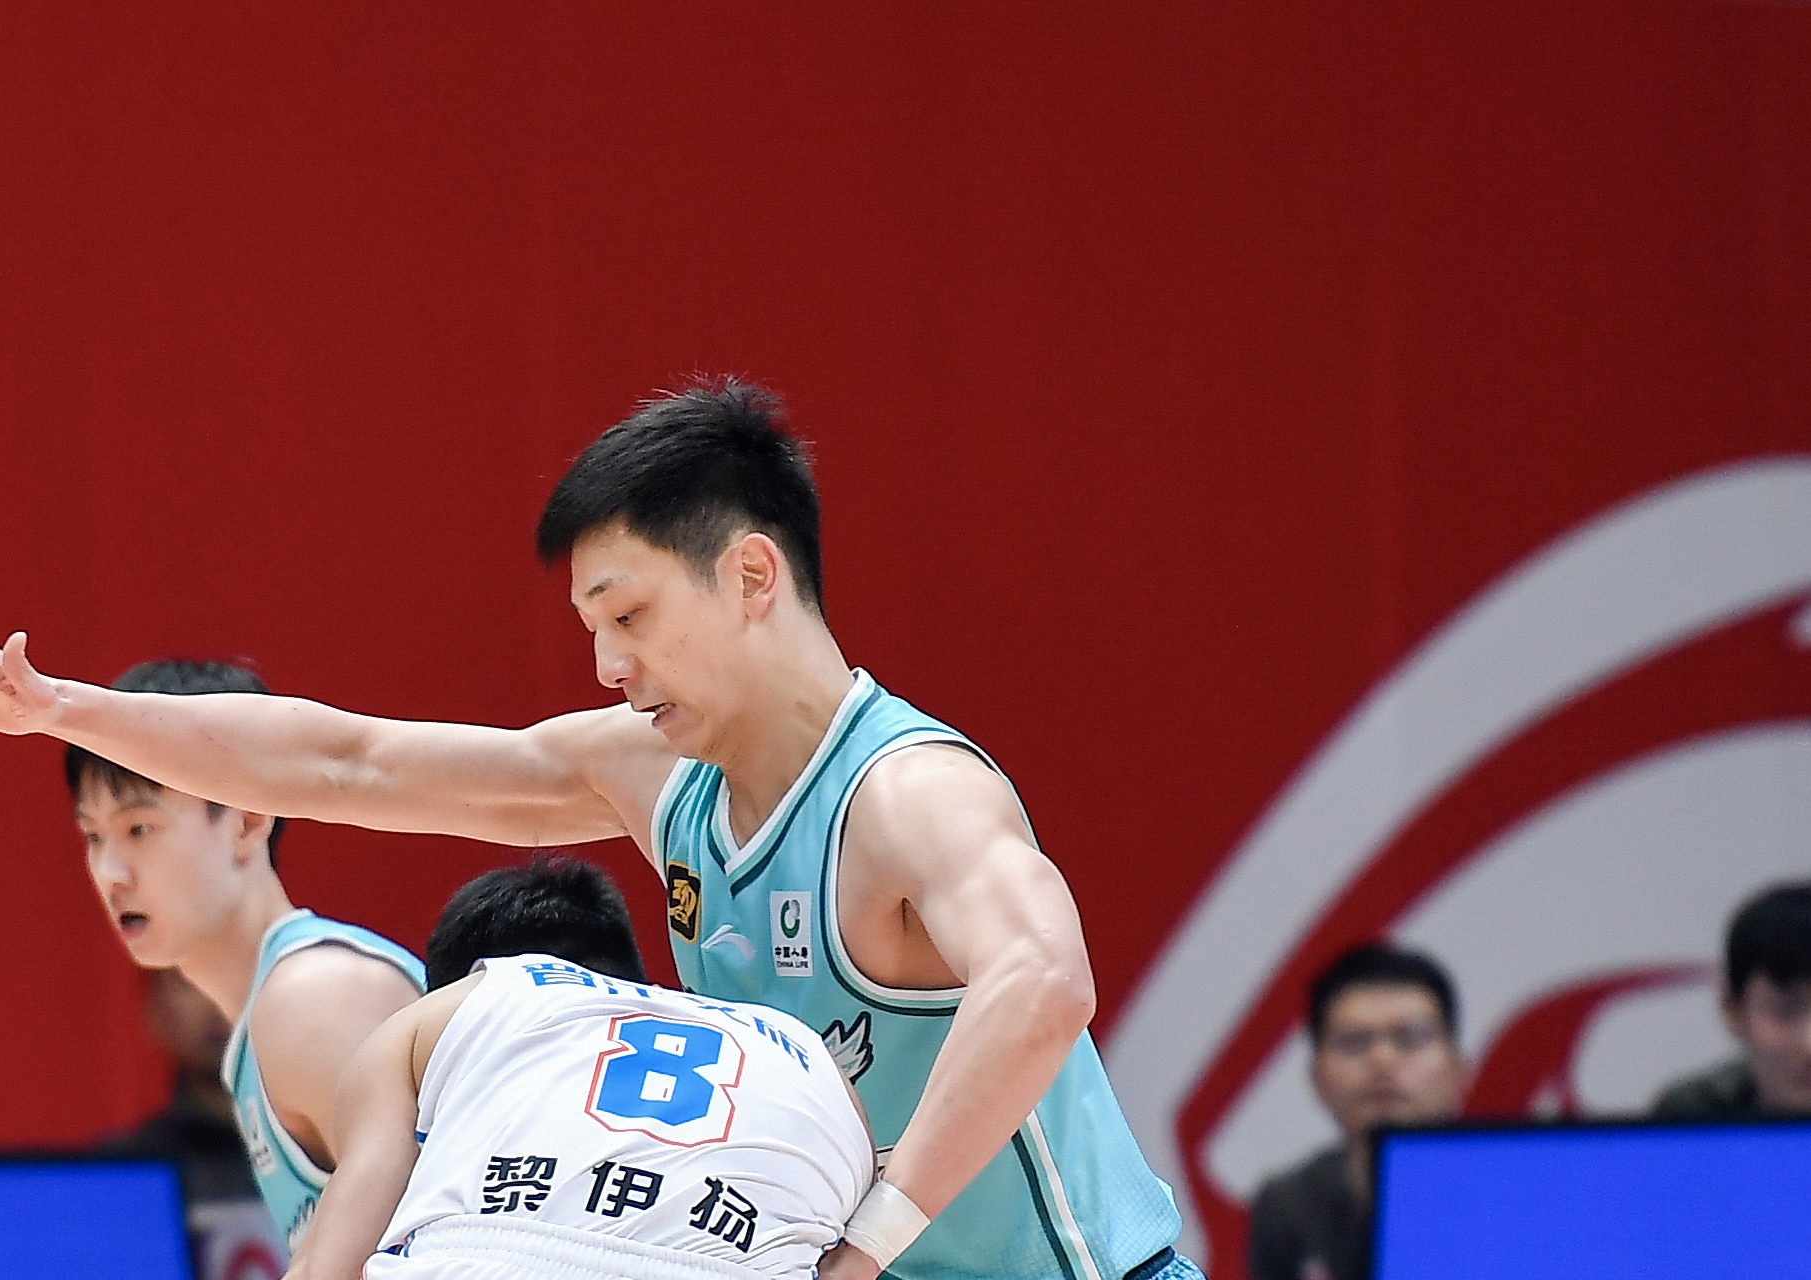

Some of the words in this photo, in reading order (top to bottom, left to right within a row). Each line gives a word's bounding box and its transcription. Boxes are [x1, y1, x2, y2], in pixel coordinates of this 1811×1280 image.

[586, 1013, 746, 1147] 8
[479, 1156, 759, 1253] 黎伊扬
